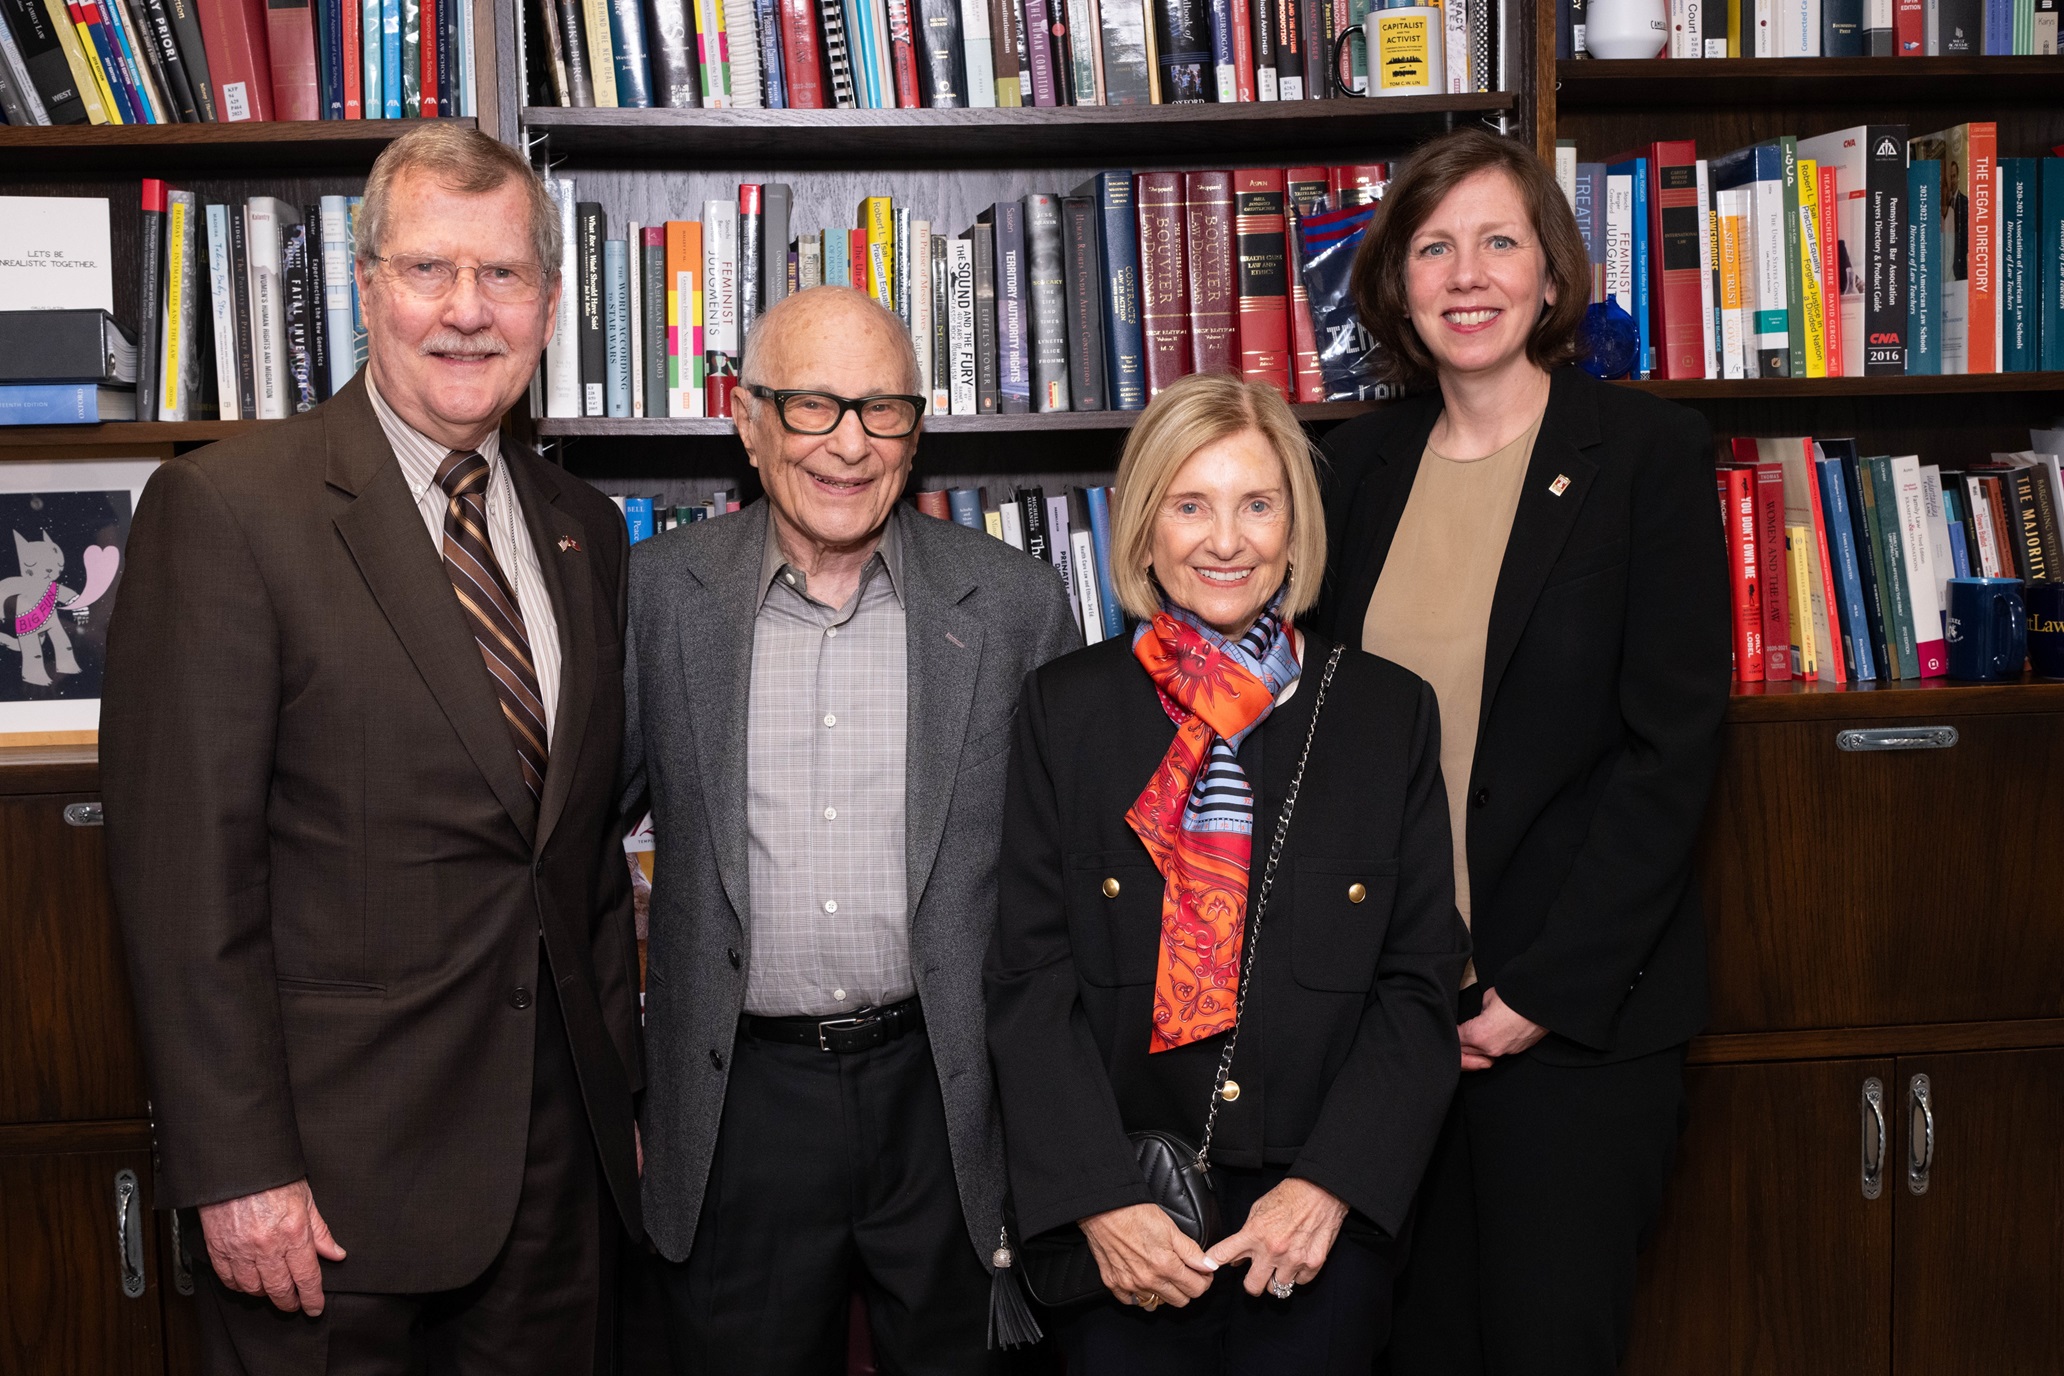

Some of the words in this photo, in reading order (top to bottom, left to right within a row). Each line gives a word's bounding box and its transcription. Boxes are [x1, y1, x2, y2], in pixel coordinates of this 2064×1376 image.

[25, 0, 40, 26] FAMILY
[35, 25, 46, 41] LAW
[566, 15, 579, 47] MIKE
[1382, 22, 1423, 31] CAPITALIST
[1688, 4, 1697, 34] Court
[2038, 17, 2056, 26] Kairys
[154, 17, 178, 62] PRIORI
[1031, 21, 1044, 51] HUMAN
[1219, 12, 1229, 62] SURROGACY
[1386, 36, 1420, 44] ACTIVIST
[570, 50, 583, 83] BURG
[1034, 54, 1050, 100] CONDITION
[52, 89, 72, 103] WEST
[1801, 164, 1813, 194] Robert
[1976, 156, 1988, 179] THE
[1699, 184, 1708, 227] GUILTY
[1807, 194, 1815, 202] L.
[1809, 203, 1819, 220] Tsai
[1873, 191, 1883, 219] Lawyers
[1976, 184, 1988, 223] LEGAL
[873, 201, 884, 230] Robert
[1802, 206, 1816, 241] Practical
[1824, 206, 1833, 243] TOUCHED
[1889, 198, 1897, 244] Pennsylvania
[878, 231, 886, 240] L.
[921, 229, 927, 238] In
[1709, 211, 1719, 271] POWERHOUSE
[1873, 220, 1883, 254] Directory
[1909, 225, 1918, 255] Directory
[881, 241, 890, 258] Tsai
[920, 241, 928, 266] Praise
[956, 245, 965, 262] THE
[1157, 217, 1172, 304] BOUVIER
[1205, 215, 1221, 302] BOUVIER
[1620, 232, 1630, 294] FEMINIST
[1701, 228, 1710, 290] PLEASURES
[1808, 242, 1821, 274] Equality
[1908, 257, 1917, 265] of
[1975, 225, 1988, 292] DIRECTORY
[312, 259, 321, 304] Experiencing
[920, 269, 928, 277] of
[1873, 262, 1882, 290] Product
[1920, 261, 1927, 272] of
[260, 274, 268, 304] WOMEN'S
[291, 279, 303, 315] FATAL
[590, 274, 598, 297] Should
[608, 292, 613, 302] TO
[706, 250, 720, 336] JUDGMENTS
[722, 261, 734, 325] FEMINIST
[919, 280, 928, 306] Messy
[955, 262, 973, 309] SOUND
[1118, 285, 1124, 294] IN
[1125, 266, 1136, 325] CONTRACTS
[1802, 258, 1816, 290] Forging
[1810, 290, 1822, 319] Justice
[1817, 320, 1824, 328] in
[261, 305, 269, 327] HUMAN
[618, 283, 627, 322] WORLD
[655, 282, 663, 322] AMERICAN
[1828, 294, 1836, 316] DAVID
[1873, 291, 1881, 312] Guide
[607, 303, 617, 331] STAR
[962, 310, 972, 328] AND
[982, 308, 990, 348] EIFFEL'S
[1806, 302, 1818, 332] Divided
[1812, 332, 1824, 361] Nation
[608, 334, 618, 365] WARS
[963, 332, 972, 348] THE
[1829, 319, 1837, 350] GERGEN
[1870, 332, 1900, 344] CNA
[294, 324, 308, 390] INVENTION
[618, 324, 629, 390] ACCORDING
[959, 352, 975, 387] FURY
[982, 351, 990, 385] TOWER
[1870, 351, 1899, 361] 2016
[265, 366, 273, 399] MIGRATION
[2016, 476, 2030, 502] THE
[1026, 497, 1036, 532] ALEXANDER
[1031, 496, 1040, 527] MICHELLE
[1740, 496, 1752, 516] YOU
[634, 520, 642, 541] Peace
[1741, 516, 1754, 542] DON'T
[1766, 500, 1776, 544] WOMEN
[1743, 543, 1755, 565] OWN
[1768, 548, 1778, 572] AND
[2022, 510, 2046, 580] MAJORITY
[1744, 565, 1756, 579] ME
[1769, 575, 1779, 598] THE
[1770, 600, 1781, 623] LAW
